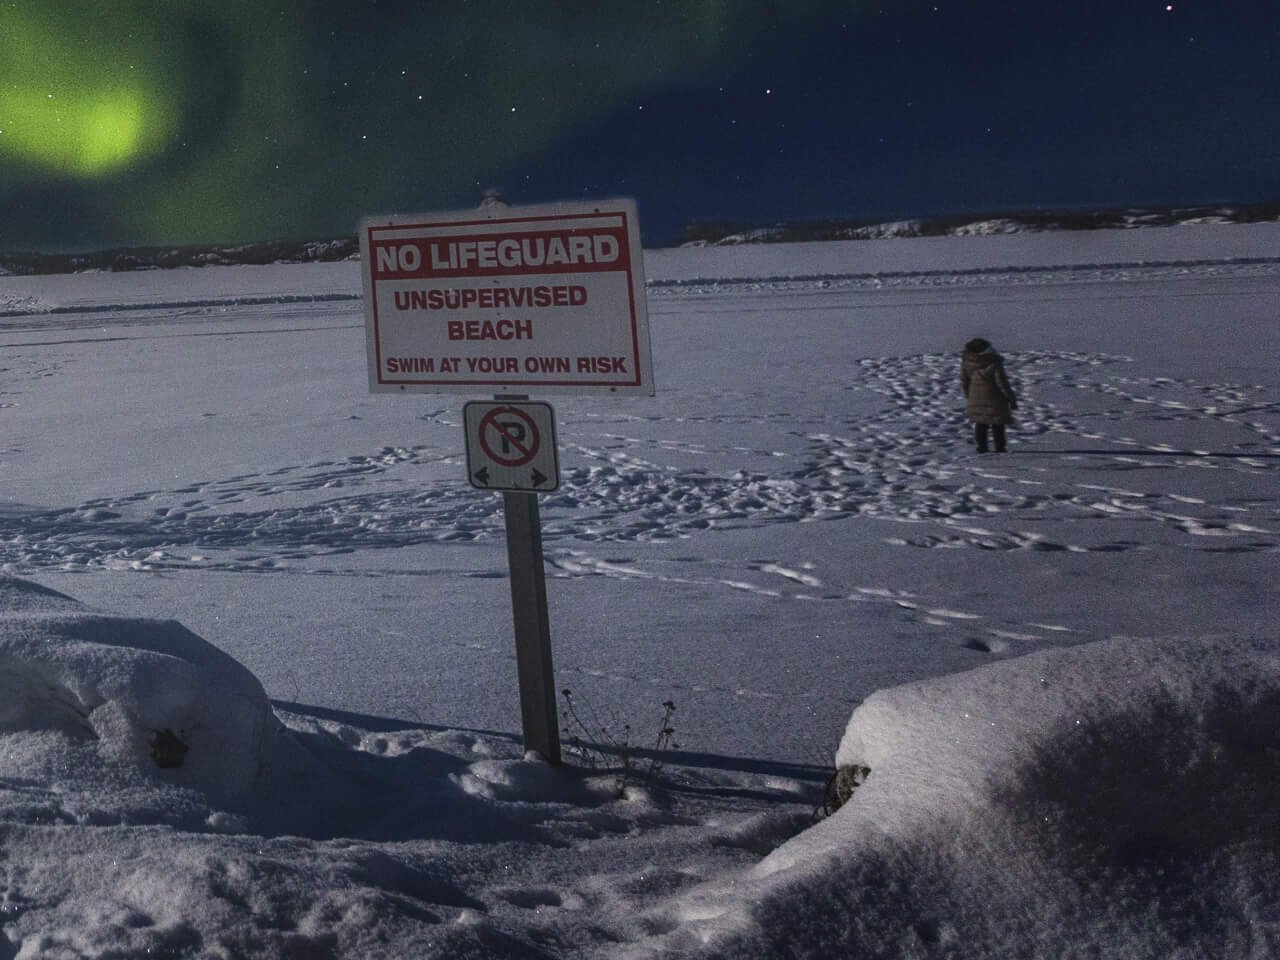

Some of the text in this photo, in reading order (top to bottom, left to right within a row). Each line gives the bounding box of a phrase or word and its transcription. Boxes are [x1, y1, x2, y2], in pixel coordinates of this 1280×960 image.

[375, 235, 619, 271] NO LIFEGUARD
[395, 285, 587, 310] UNSUPERVISED
[448, 320, 533, 340] BEACH
[387, 357, 627, 373] SWIM AT YOUR OWN RISK
